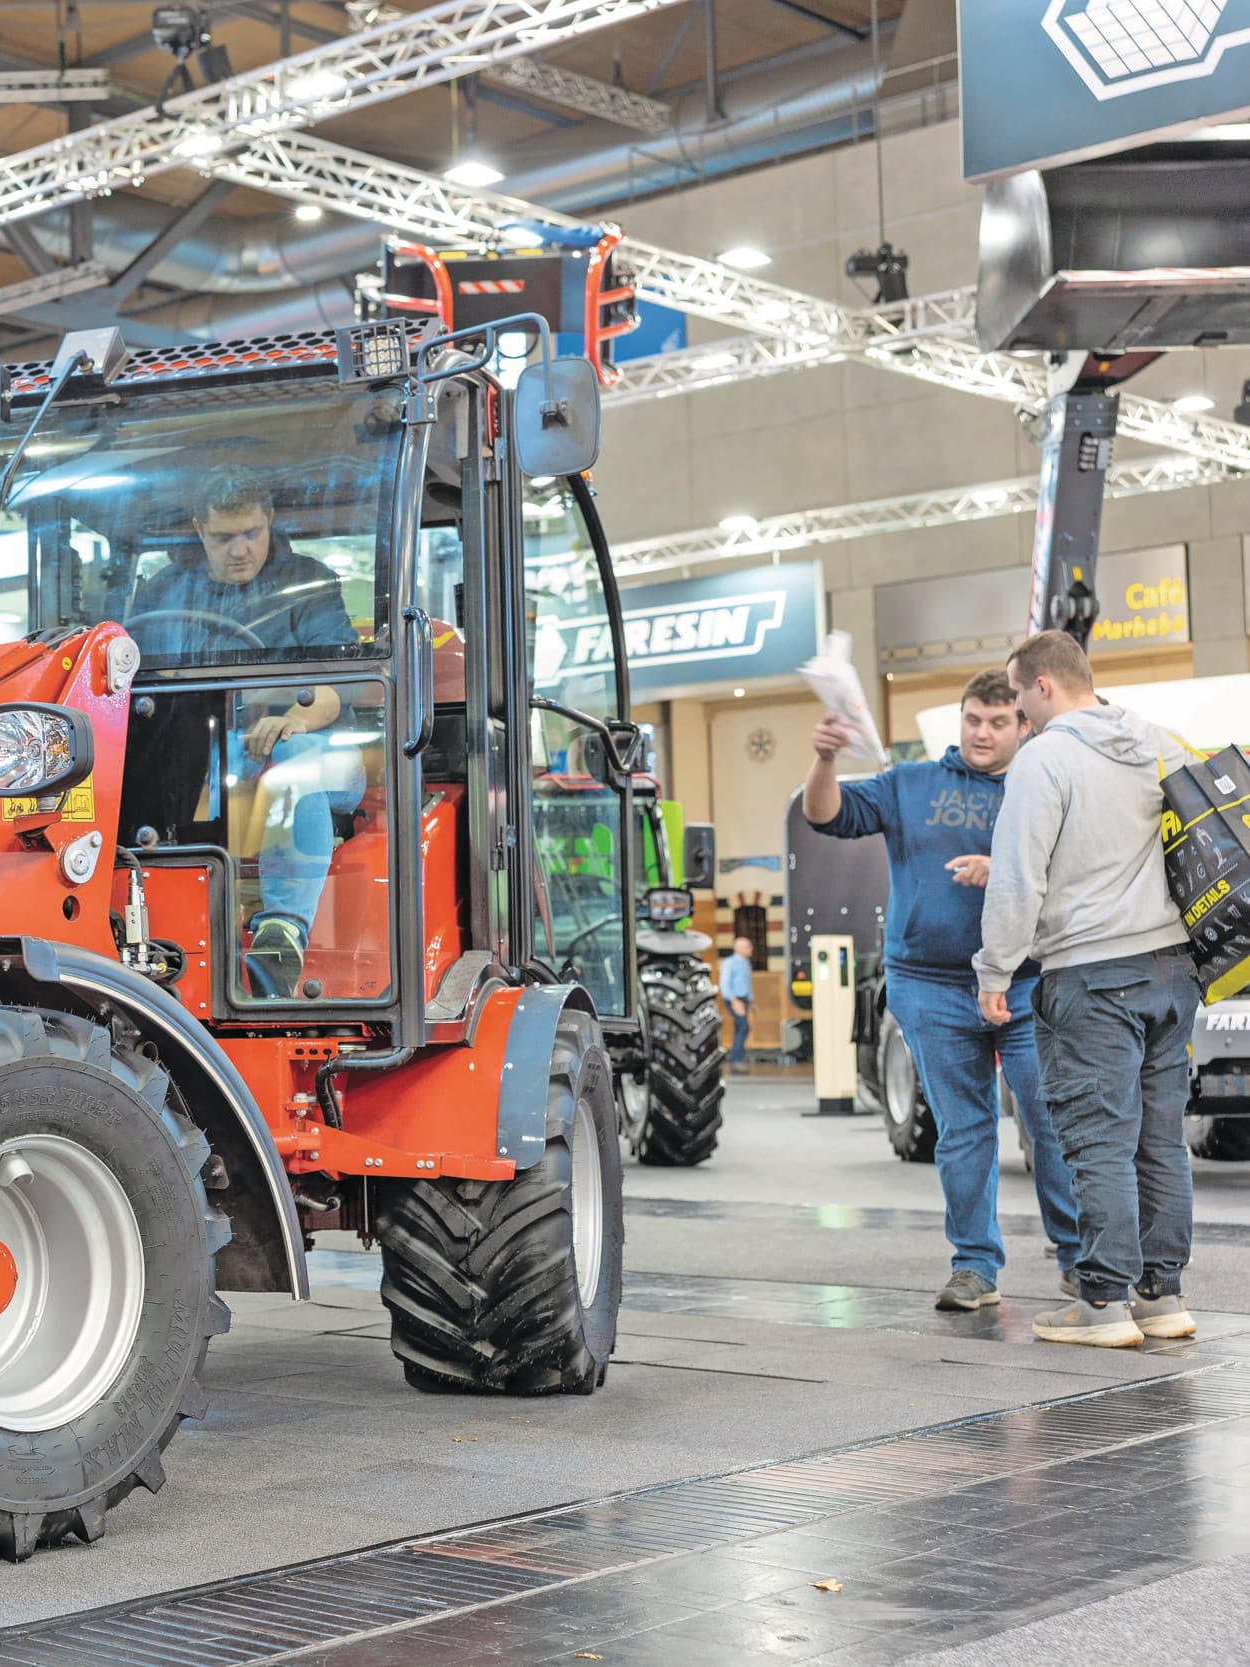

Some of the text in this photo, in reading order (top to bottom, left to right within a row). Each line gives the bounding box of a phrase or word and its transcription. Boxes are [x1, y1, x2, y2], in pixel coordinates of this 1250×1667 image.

[925, 808, 996, 831] JON
[1191, 879, 1231, 919] DETAILS
[1205, 1014, 1250, 1031] FAR
